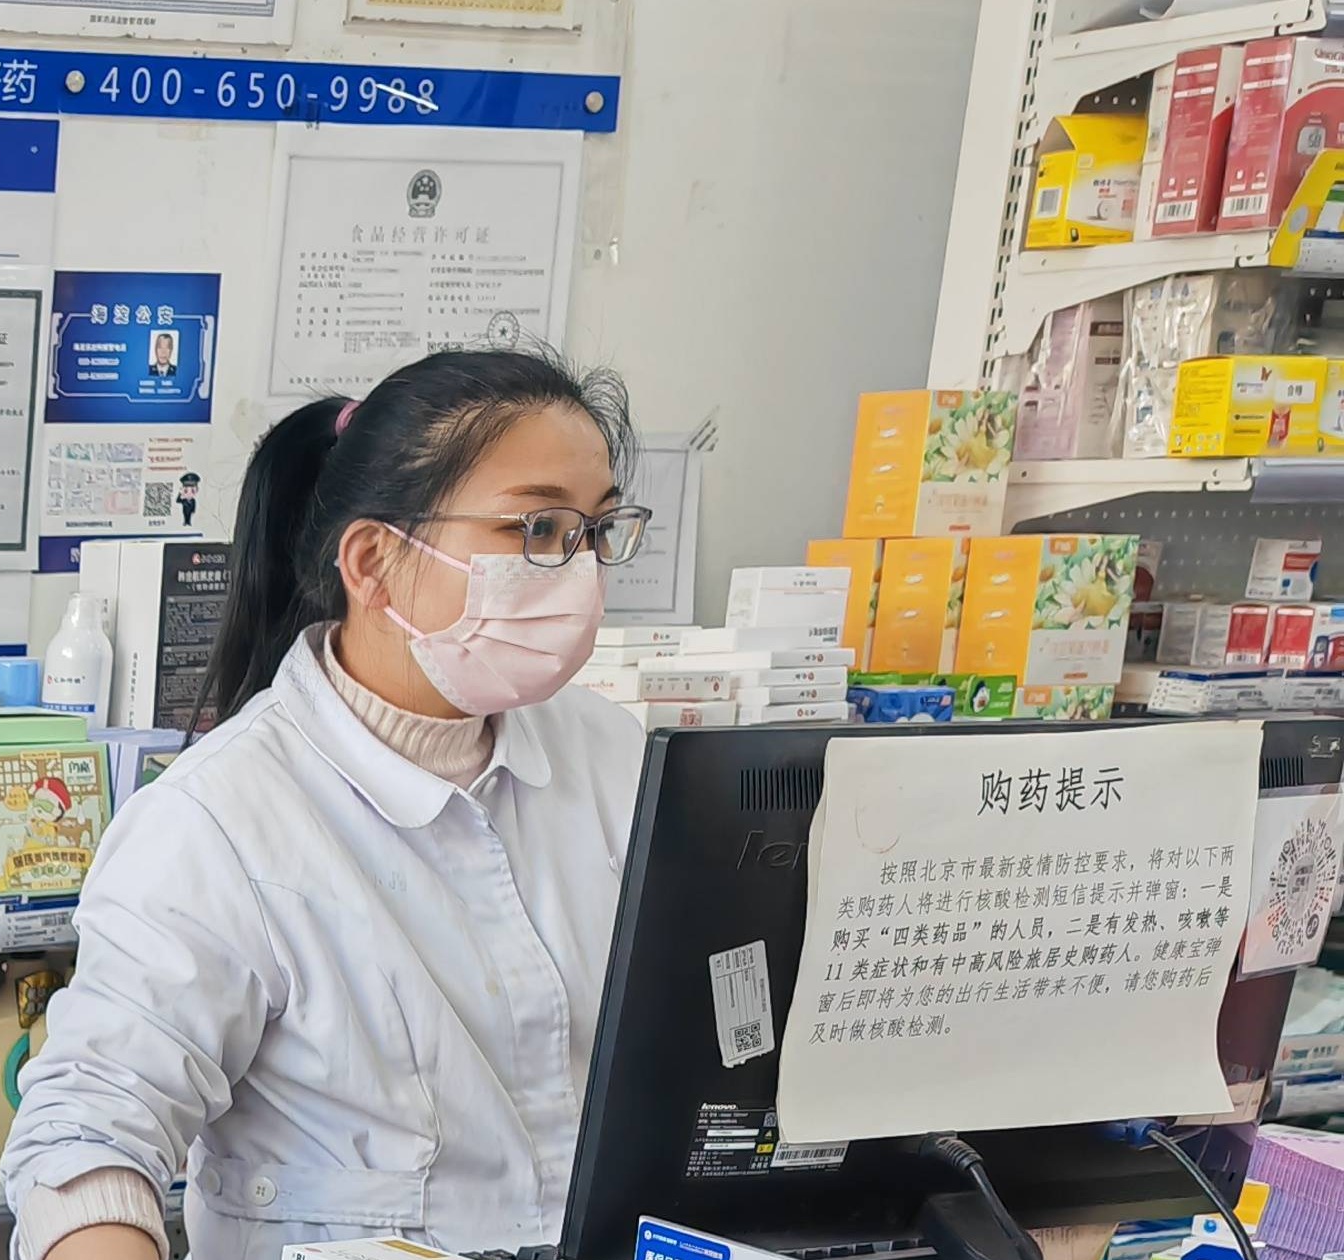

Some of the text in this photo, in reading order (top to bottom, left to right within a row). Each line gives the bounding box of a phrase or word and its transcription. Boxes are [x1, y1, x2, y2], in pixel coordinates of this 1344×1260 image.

[98, 65, 439, 115] 400-650-9988
[976, 765, 1127, 818] 购药提示
